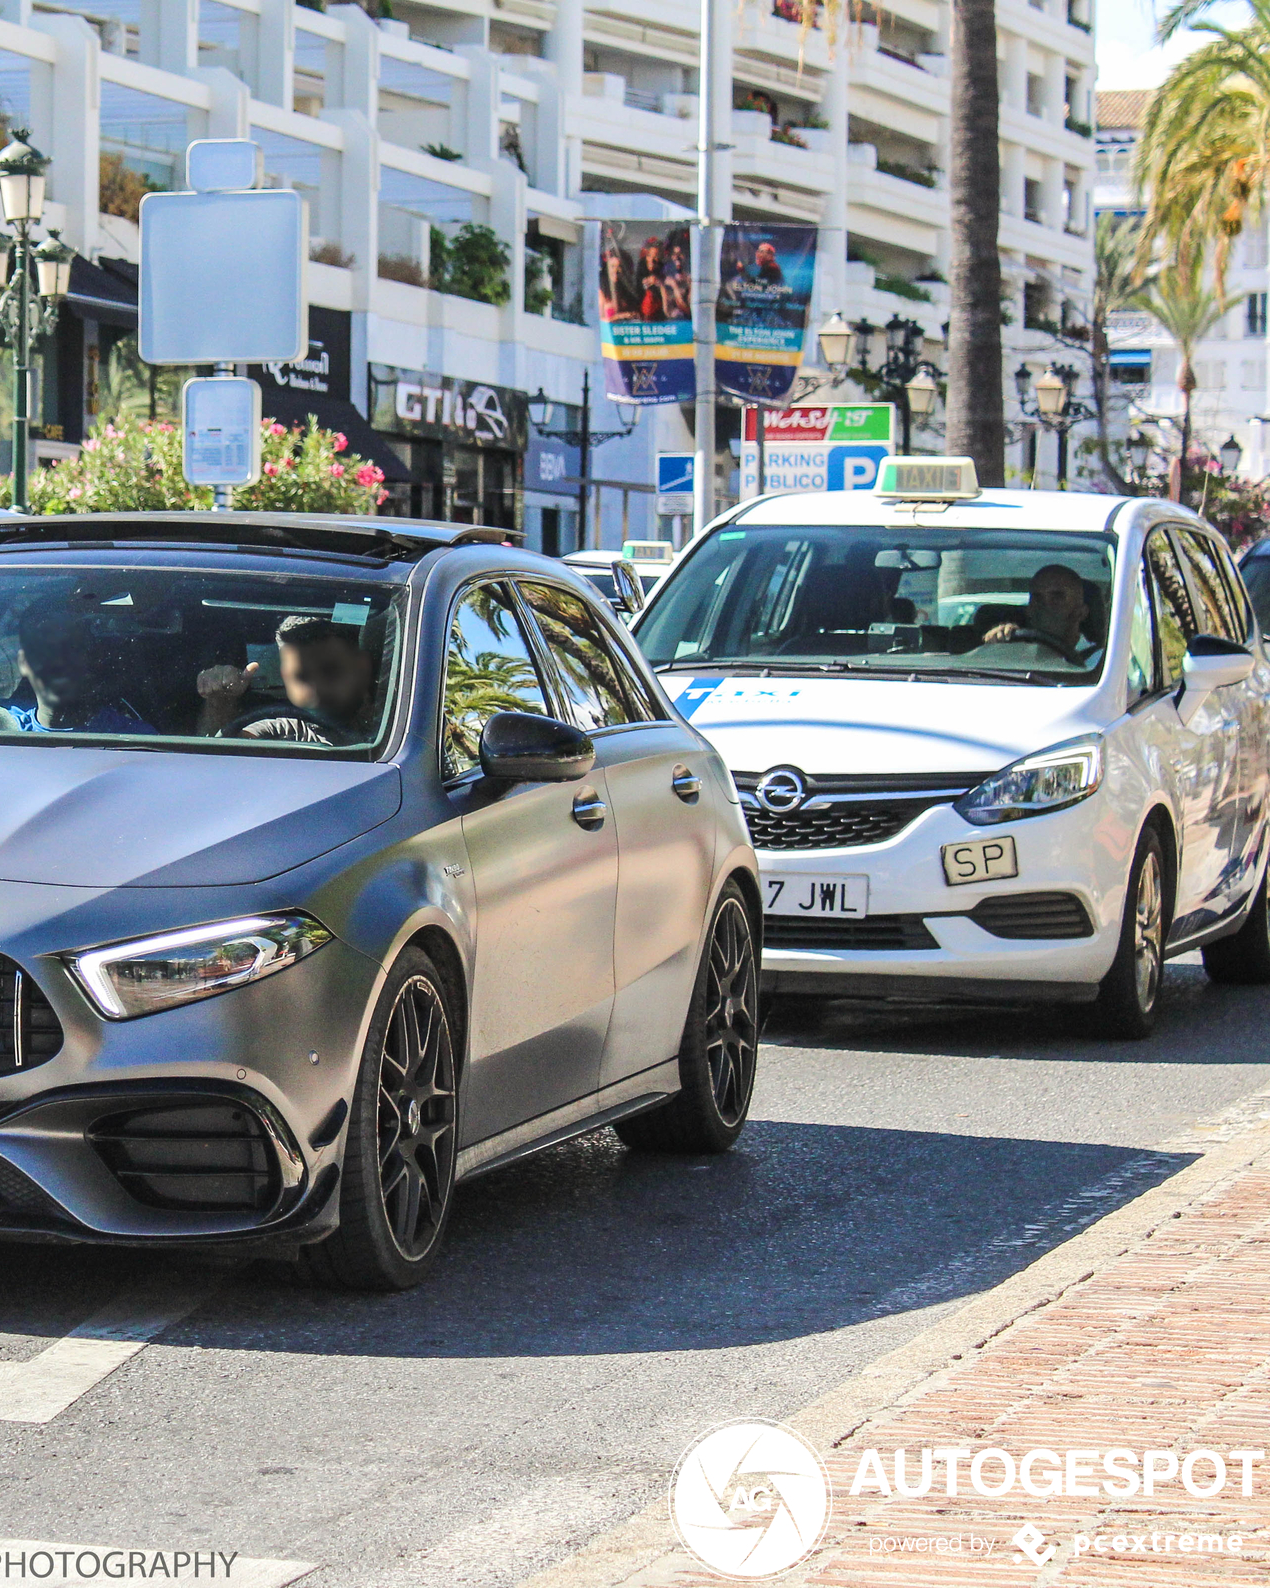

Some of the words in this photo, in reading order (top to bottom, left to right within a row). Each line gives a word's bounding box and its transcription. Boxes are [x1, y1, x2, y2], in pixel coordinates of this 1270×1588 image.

[612, 325, 641, 335] SISTER
[642, 325, 677, 335] SLEDGE
[395, 381, 451, 427] GTI
[745, 453, 825, 469] PRKING
[745, 474, 825, 490] PBLICO
[900, 466, 943, 488] TAXI
[953, 844, 1004, 877] SP
[798, 882, 857, 912] JWL
